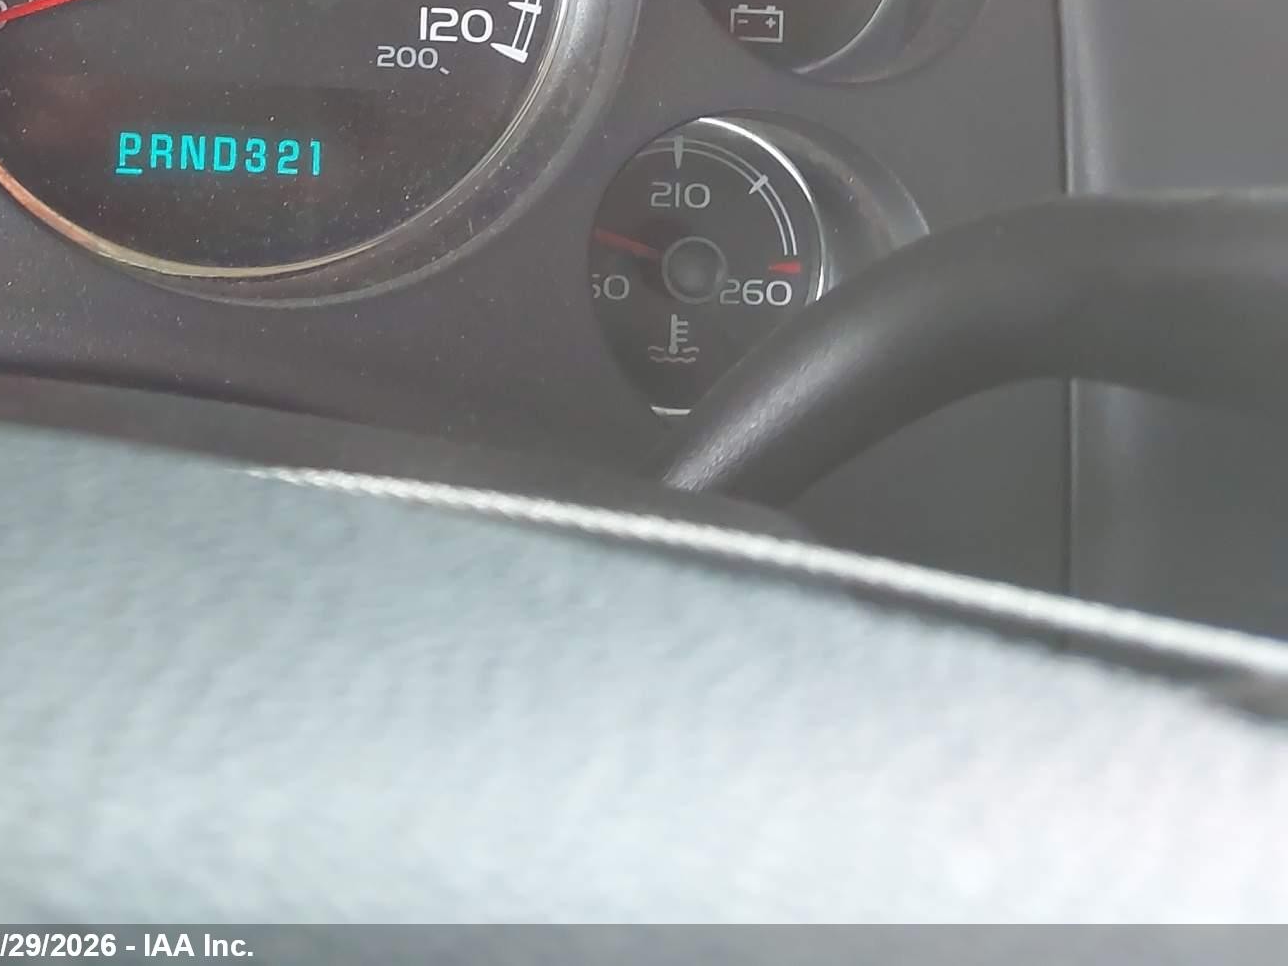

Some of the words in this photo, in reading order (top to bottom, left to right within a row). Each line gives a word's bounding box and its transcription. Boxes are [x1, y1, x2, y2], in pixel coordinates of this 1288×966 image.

[419, 8, 494, 42] 120
[377, 47, 439, 69] 200
[650, 183, 711, 209] 210
[719, 280, 792, 306] 260
